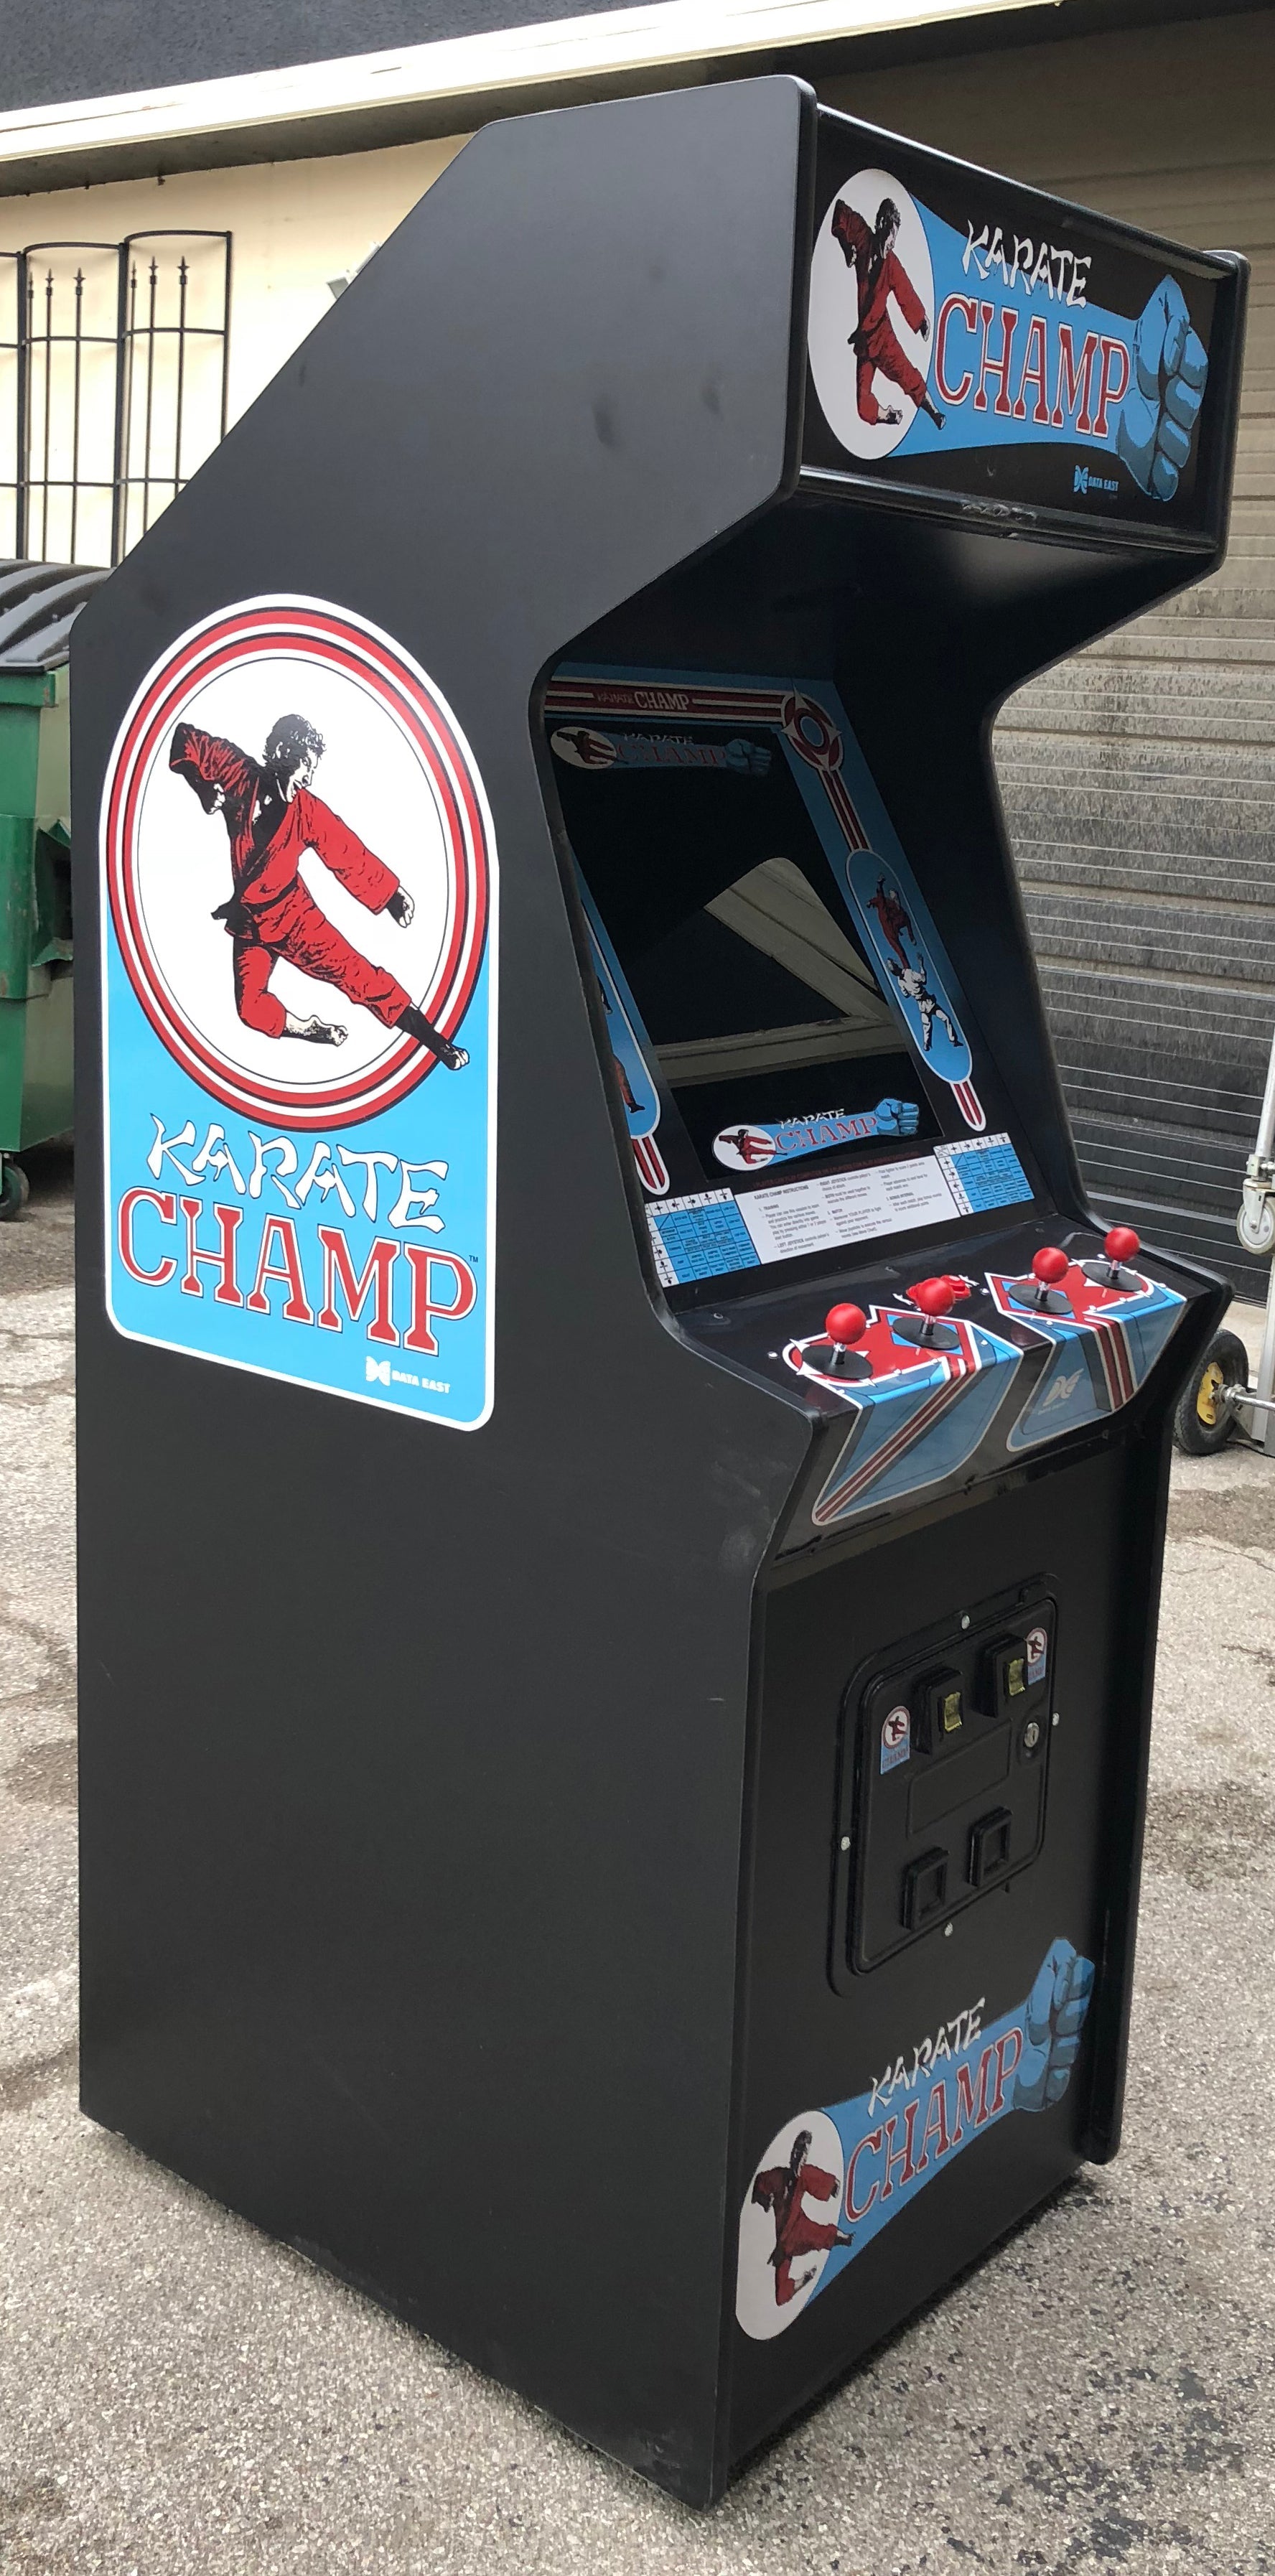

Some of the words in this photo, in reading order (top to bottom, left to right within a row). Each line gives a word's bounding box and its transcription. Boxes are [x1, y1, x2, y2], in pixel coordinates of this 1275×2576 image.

[962, 219, 1092, 309] KARATE
[934, 291, 1131, 439] CHAMP
[1088, 476, 1103, 489] DATA
[1103, 479, 1119, 492] EAST
[633, 691, 691, 711] CHAMP
[775, 1116, 877, 1150] CHAMP
[778, 1108, 845, 1129] KARATE
[146, 1112, 449, 1234] KARATE
[117, 1185, 478, 1357] CHAMP
[391, 1370, 420, 1386] DATA
[421, 1377, 451, 1394] EAST
[867, 1996, 986, 2118] KARATE
[844, 2026, 1024, 2223] CHAMP
